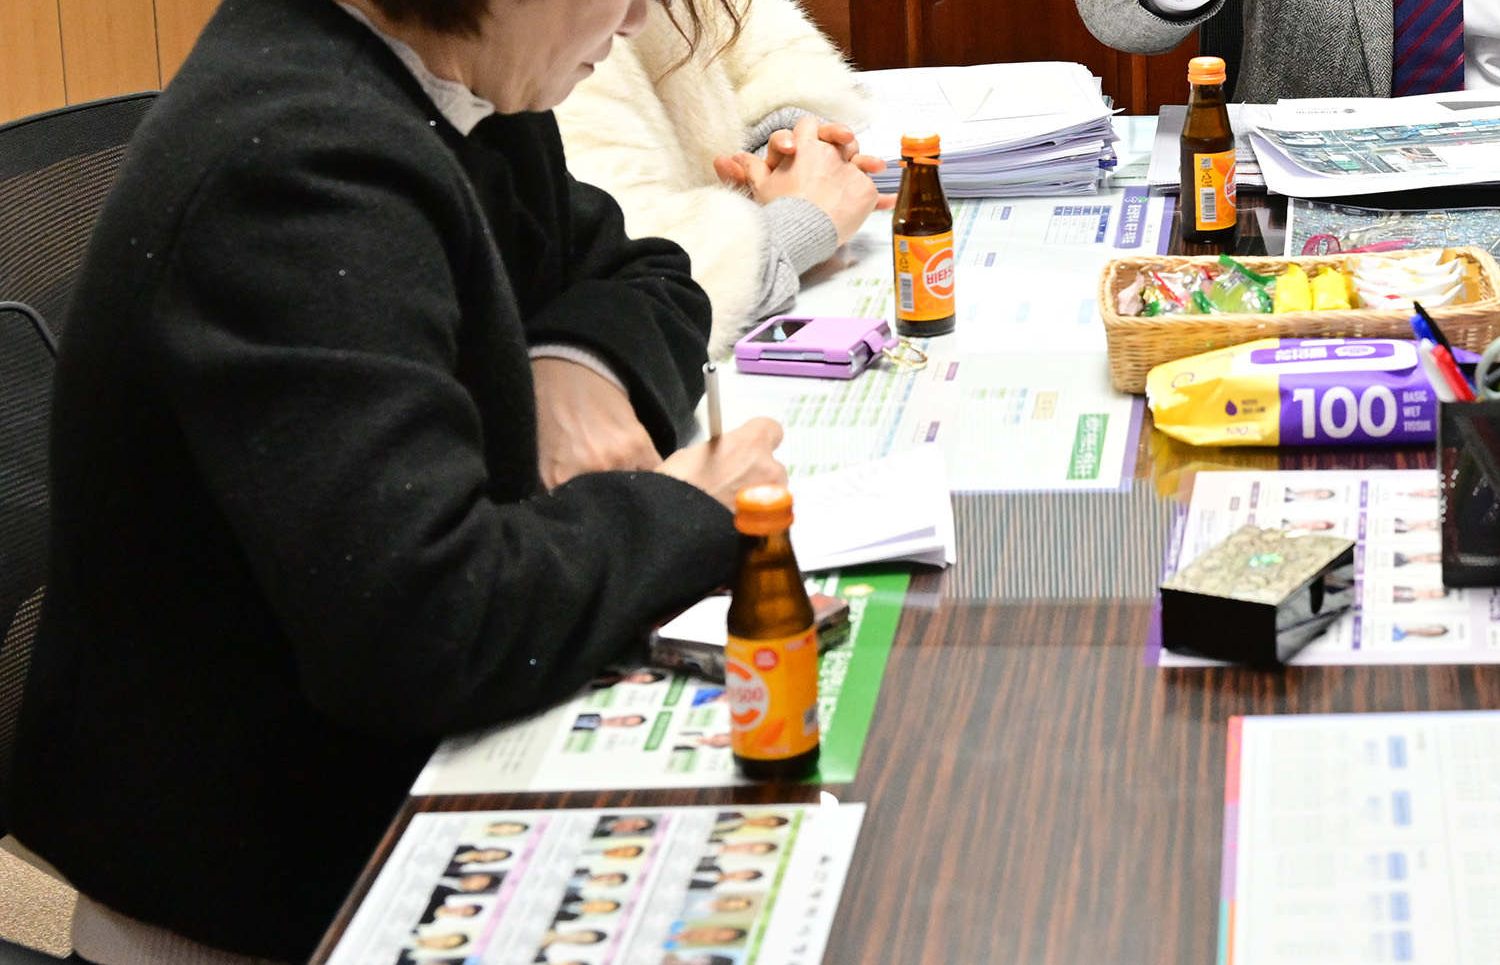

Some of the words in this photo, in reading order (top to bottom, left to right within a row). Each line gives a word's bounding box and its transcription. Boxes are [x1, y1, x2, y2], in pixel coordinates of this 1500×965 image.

[926, 265, 954, 285] 비타5
[1402, 390, 1427, 403] BASIC
[1293, 385, 1397, 439] 100
[1403, 405, 1421, 417] WET
[1404, 420, 1432, 432] TISSUE
